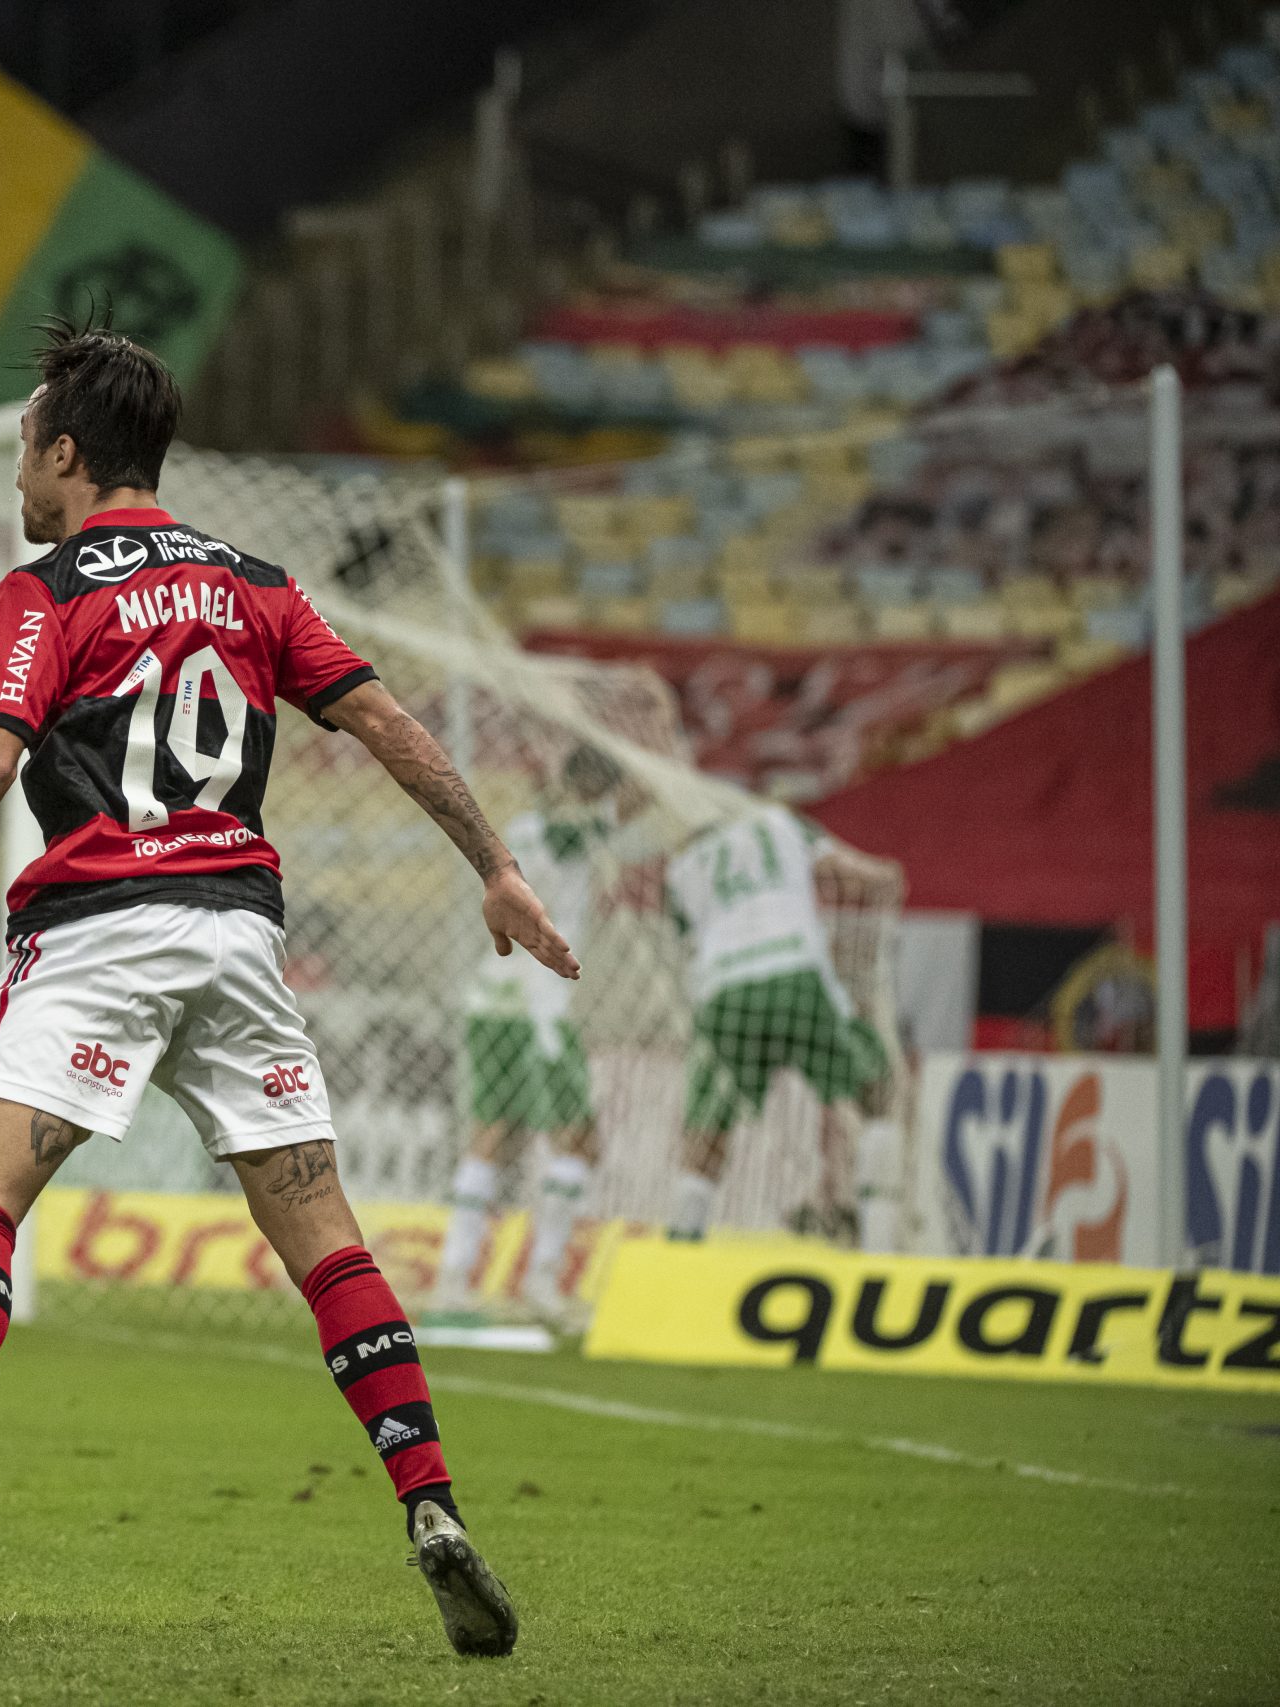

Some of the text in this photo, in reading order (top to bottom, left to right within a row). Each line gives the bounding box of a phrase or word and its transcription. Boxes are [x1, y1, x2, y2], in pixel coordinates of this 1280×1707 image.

[156, 542, 208, 561] livre
[115, 582, 243, 634] MICHAEL
[0, 609, 46, 705] HAVAN
[135, 655, 154, 673] TIM
[184, 680, 193, 701] TIM
[112, 645, 248, 832] 19
[70, 1042, 131, 1087] abc
[66, 1069, 123, 1098] da construção
[262, 1063, 310, 1098] abc
[265, 1098, 277, 1109] da
[280, 1185, 332, 1213] Fiona
